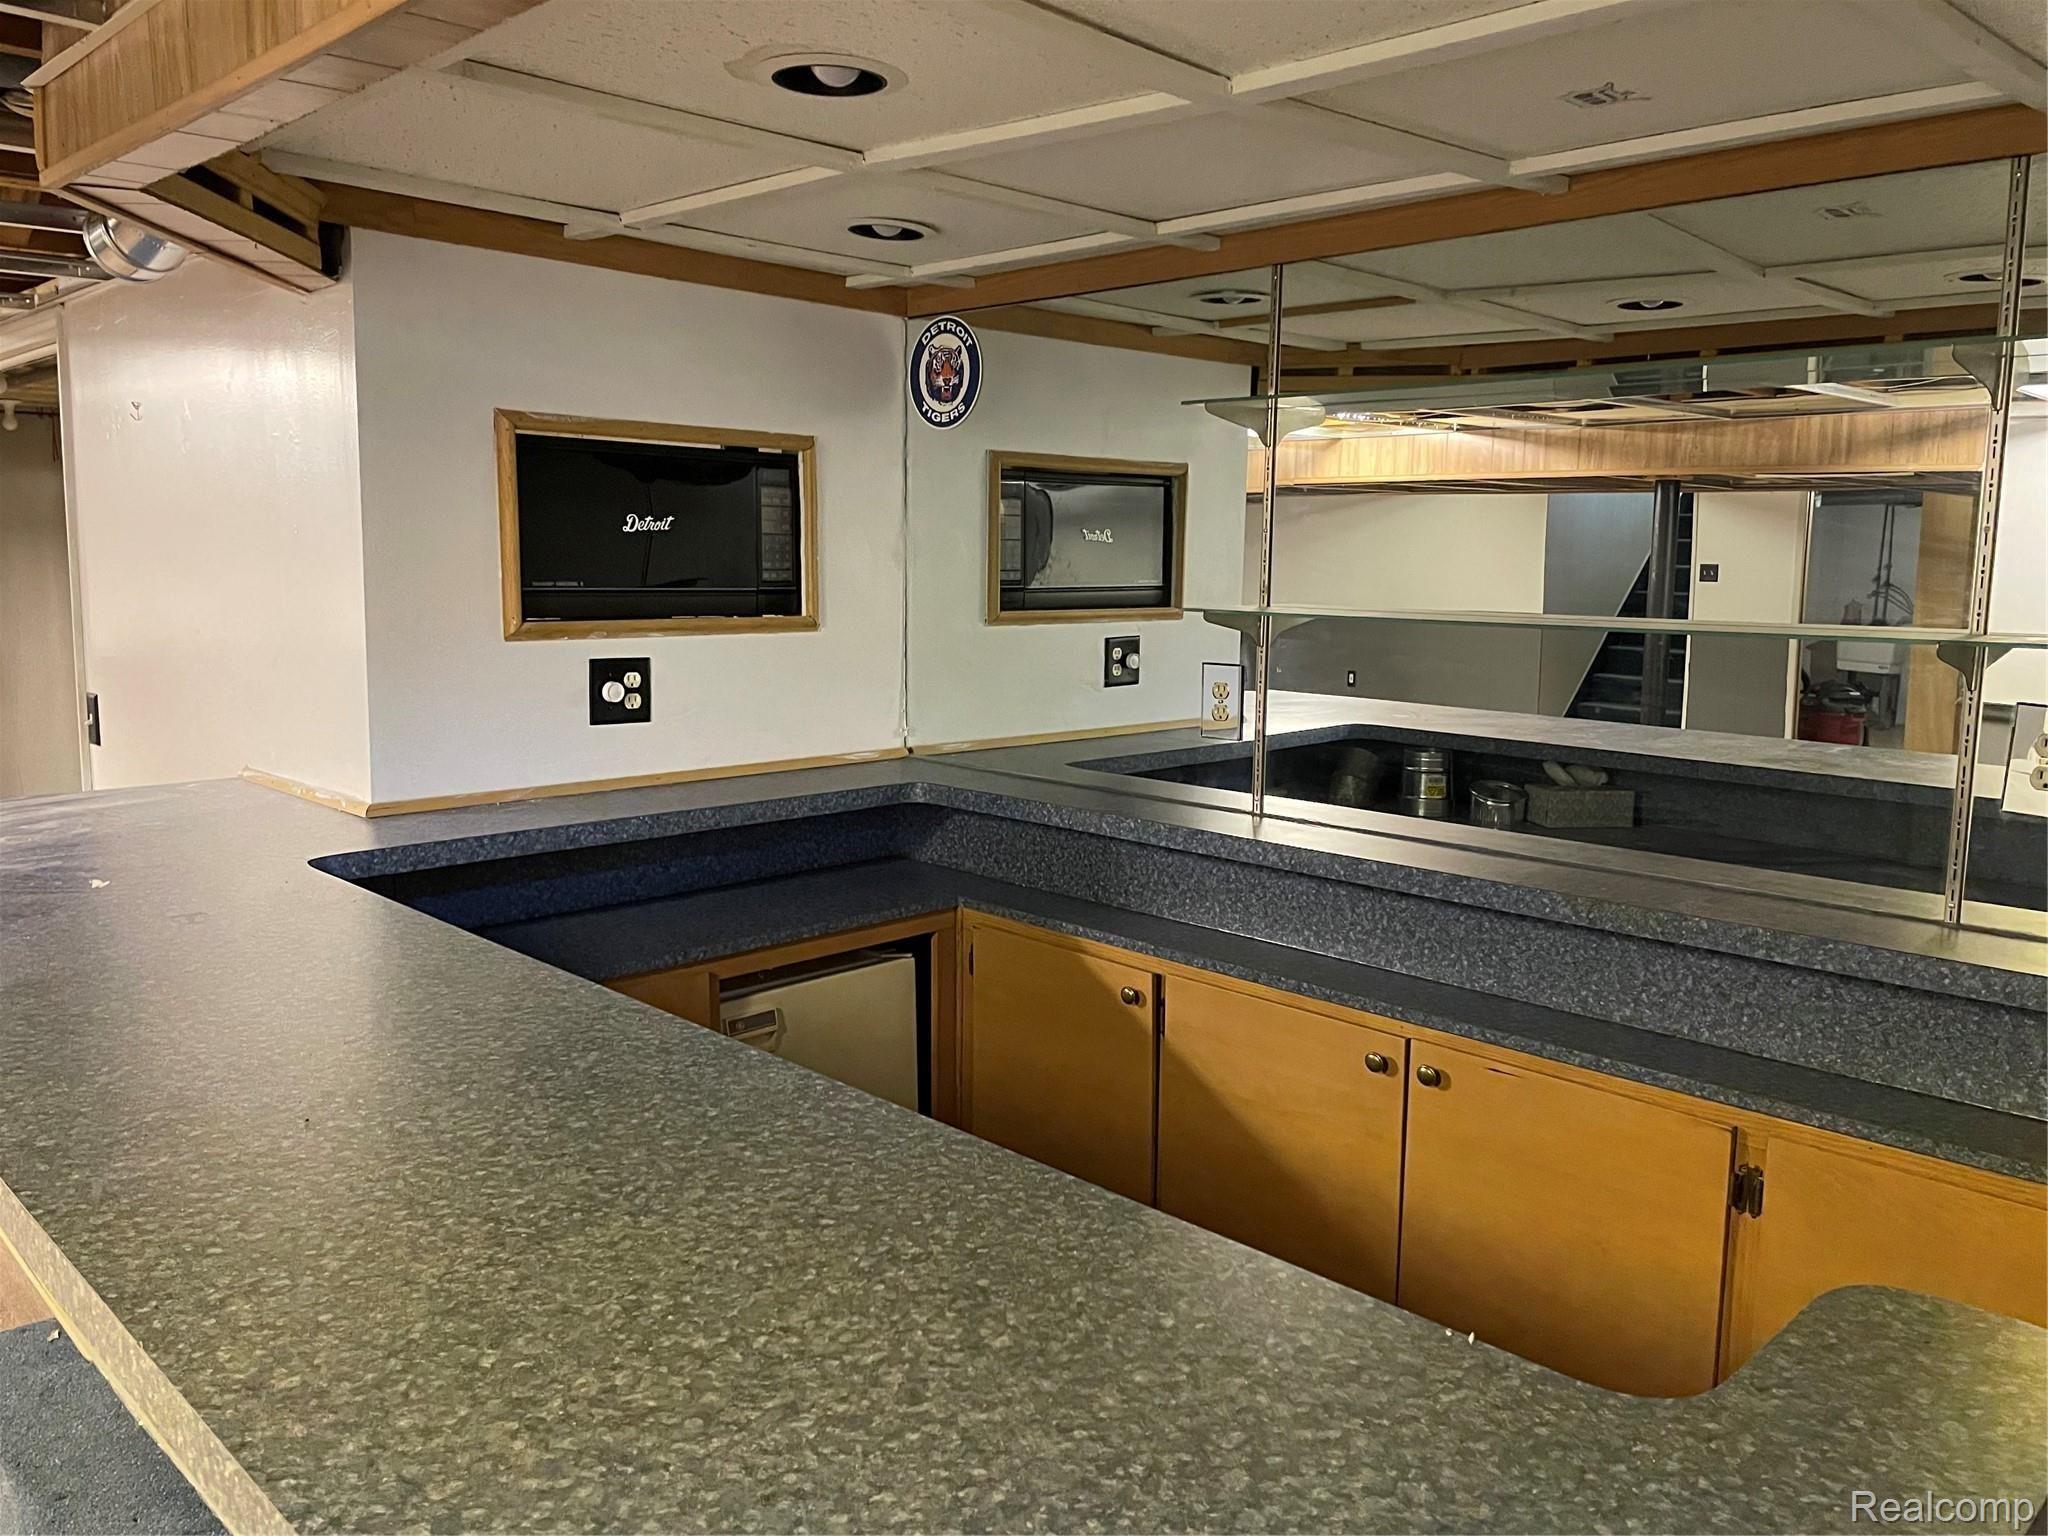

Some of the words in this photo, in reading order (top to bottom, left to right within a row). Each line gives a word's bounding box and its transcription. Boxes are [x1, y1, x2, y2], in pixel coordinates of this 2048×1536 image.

[921, 321, 973, 346] DETROIT
[921, 401, 966, 422] TIGERS
[622, 513, 675, 533] Detroit
